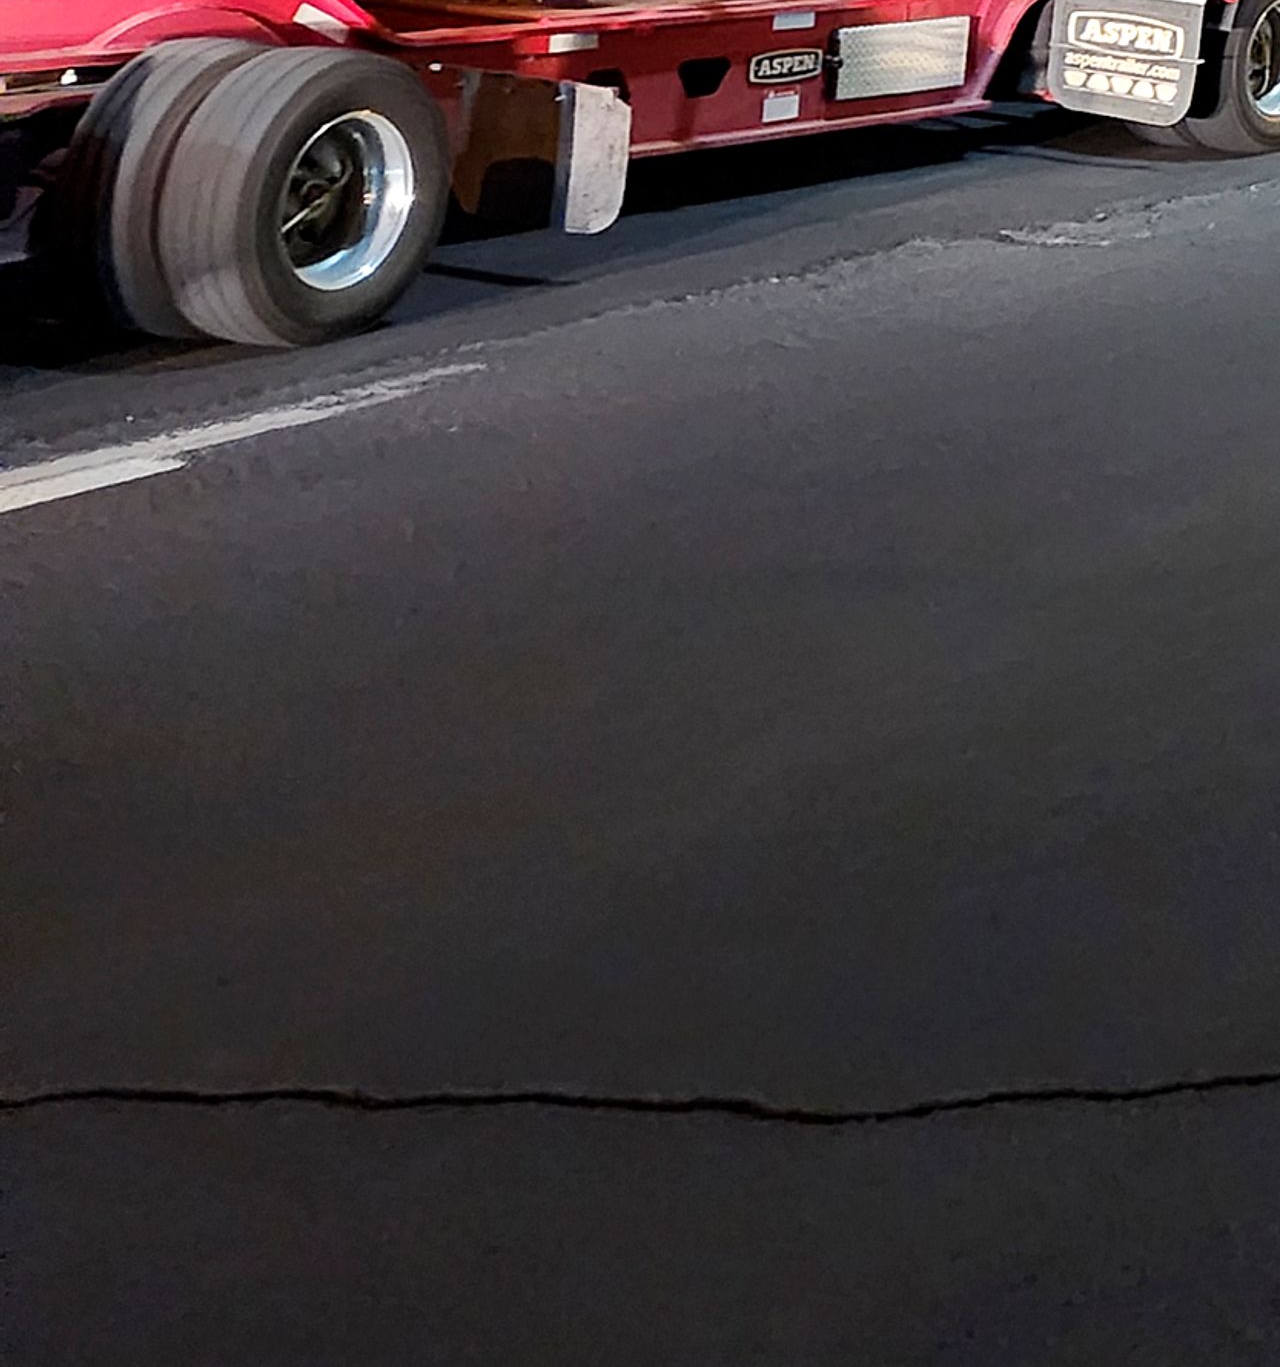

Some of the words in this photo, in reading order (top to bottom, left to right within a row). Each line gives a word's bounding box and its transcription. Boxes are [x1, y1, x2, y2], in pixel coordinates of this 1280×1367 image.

[1079, 18, 1174, 53] ASPEN
[757, 54, 816, 76] ASPEN
[1063, 52, 1180, 81] aspentrailer.com
